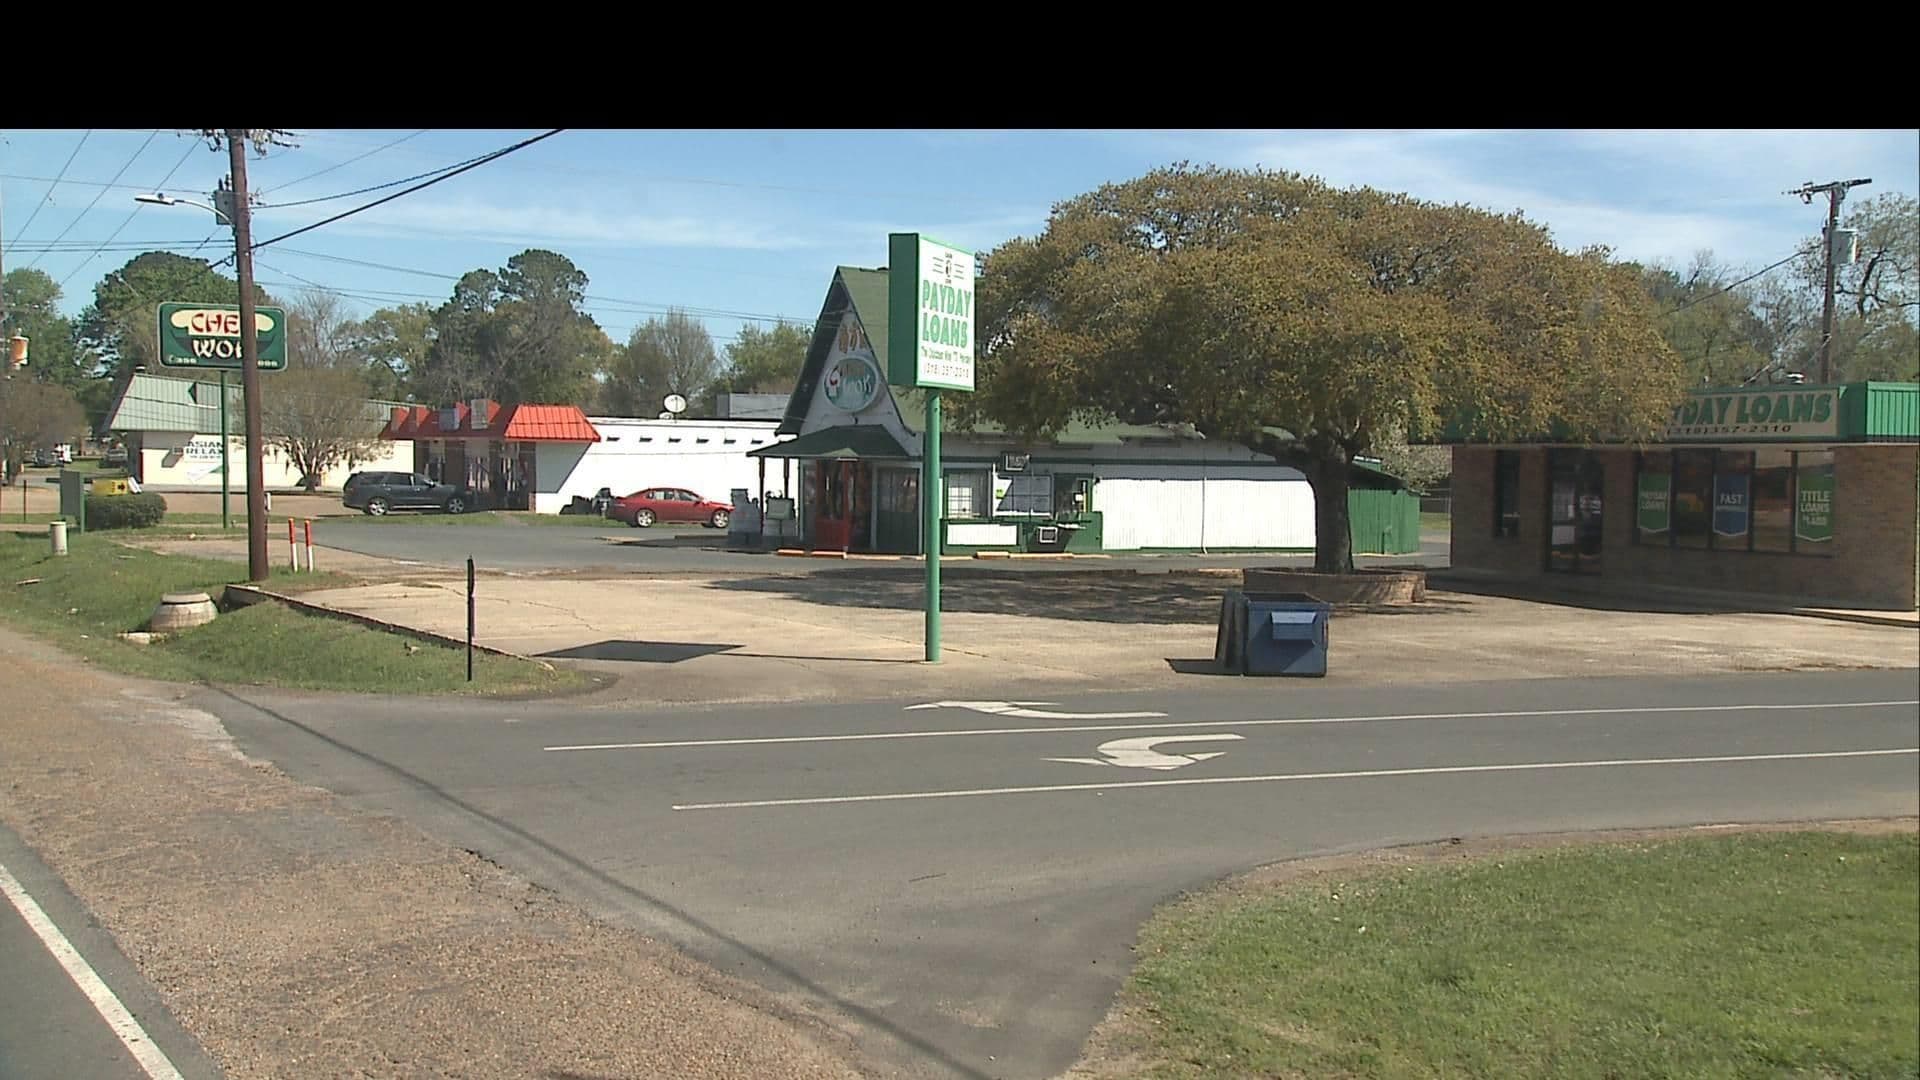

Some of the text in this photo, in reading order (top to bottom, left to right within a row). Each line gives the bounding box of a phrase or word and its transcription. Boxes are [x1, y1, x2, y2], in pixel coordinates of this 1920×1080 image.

[922, 280, 972, 318] PAYDAY
[191, 312, 240, 334] CHE
[922, 312, 968, 348] LOANS
[1735, 393, 1832, 424] LOANS
[1720, 493, 1744, 505] FAST
[1800, 503, 1830, 512] LOANS
[1801, 491, 1832, 502] TITLE
